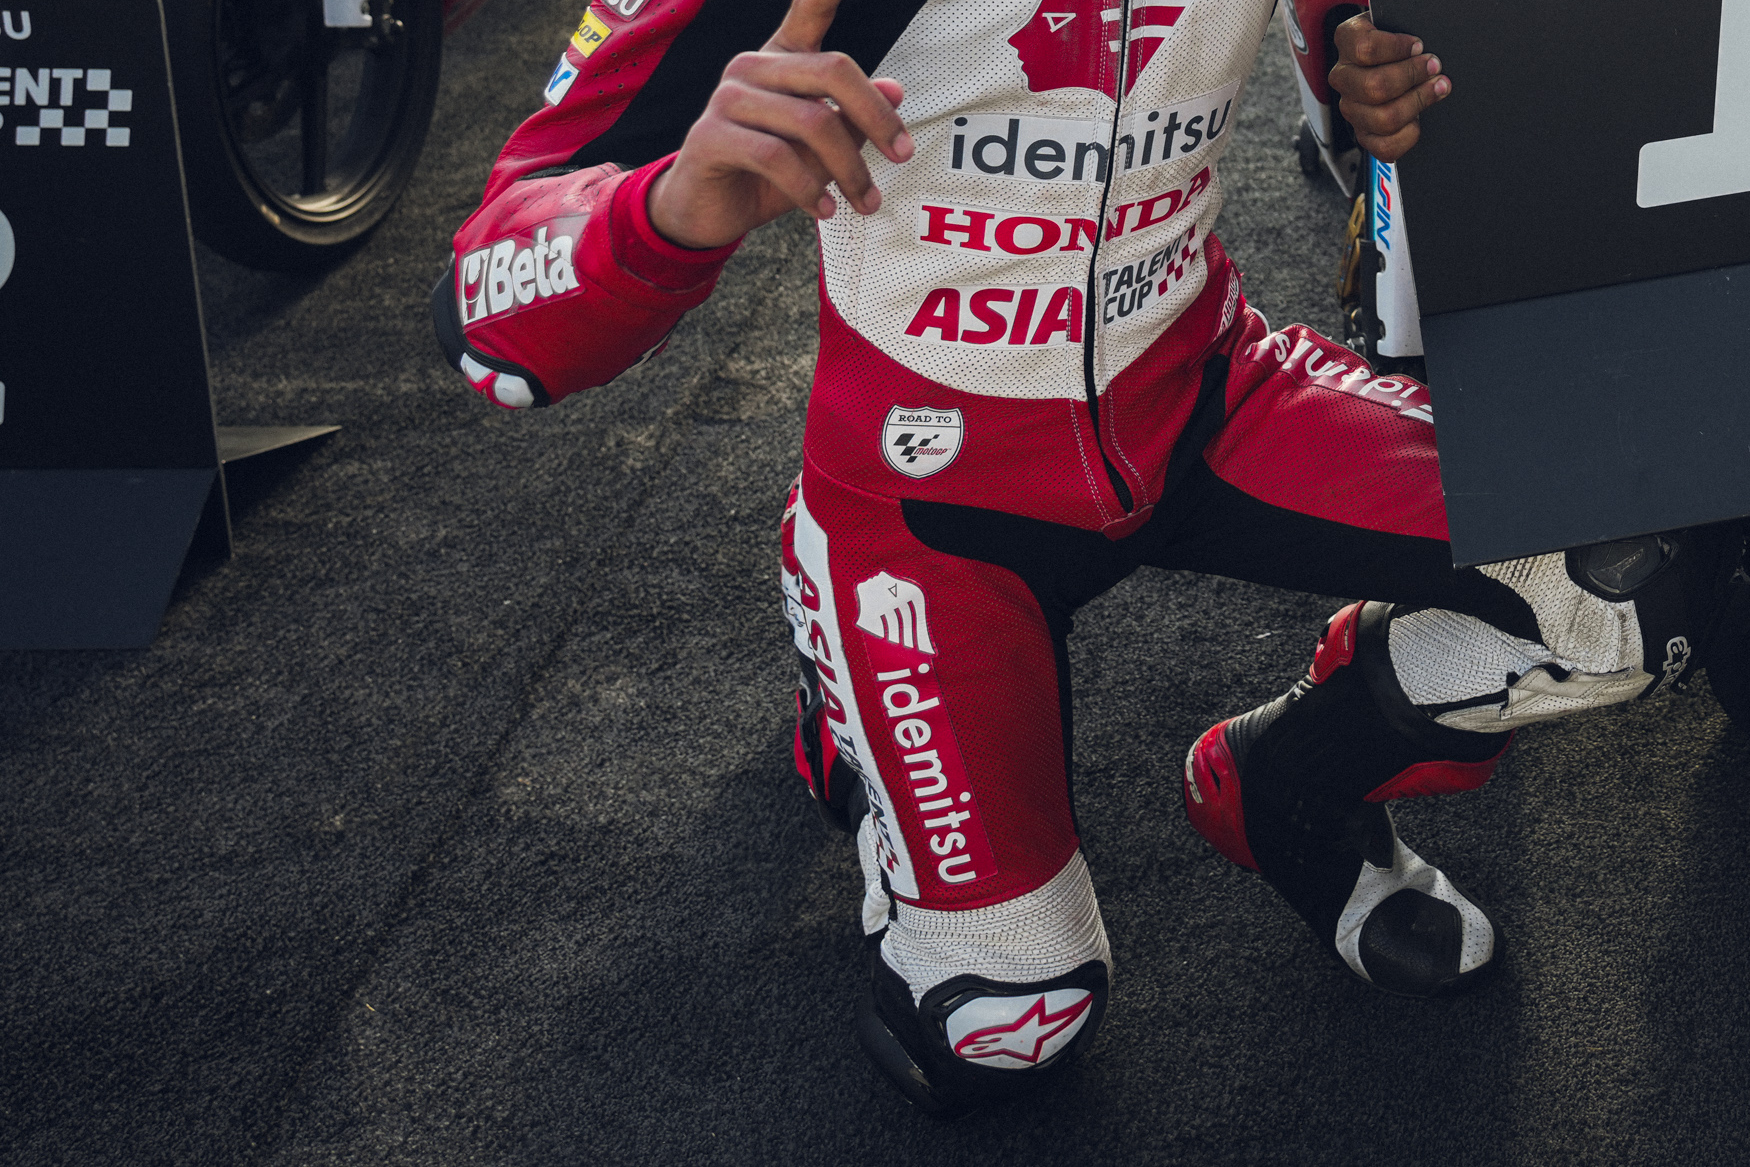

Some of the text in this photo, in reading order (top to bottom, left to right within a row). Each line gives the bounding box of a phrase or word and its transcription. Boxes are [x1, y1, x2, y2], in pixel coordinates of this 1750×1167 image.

[951, 98, 1233, 184] idemitsu
[919, 165, 1212, 256] HONDA
[488, 225, 581, 315] Beta
[1102, 229, 1192, 299] TALENT
[1103, 279, 1154, 325] CUP
[904, 287, 1084, 347] ASIA
[898, 414, 952, 424] ROAD TO
[876, 665, 977, 886] idemitsu
